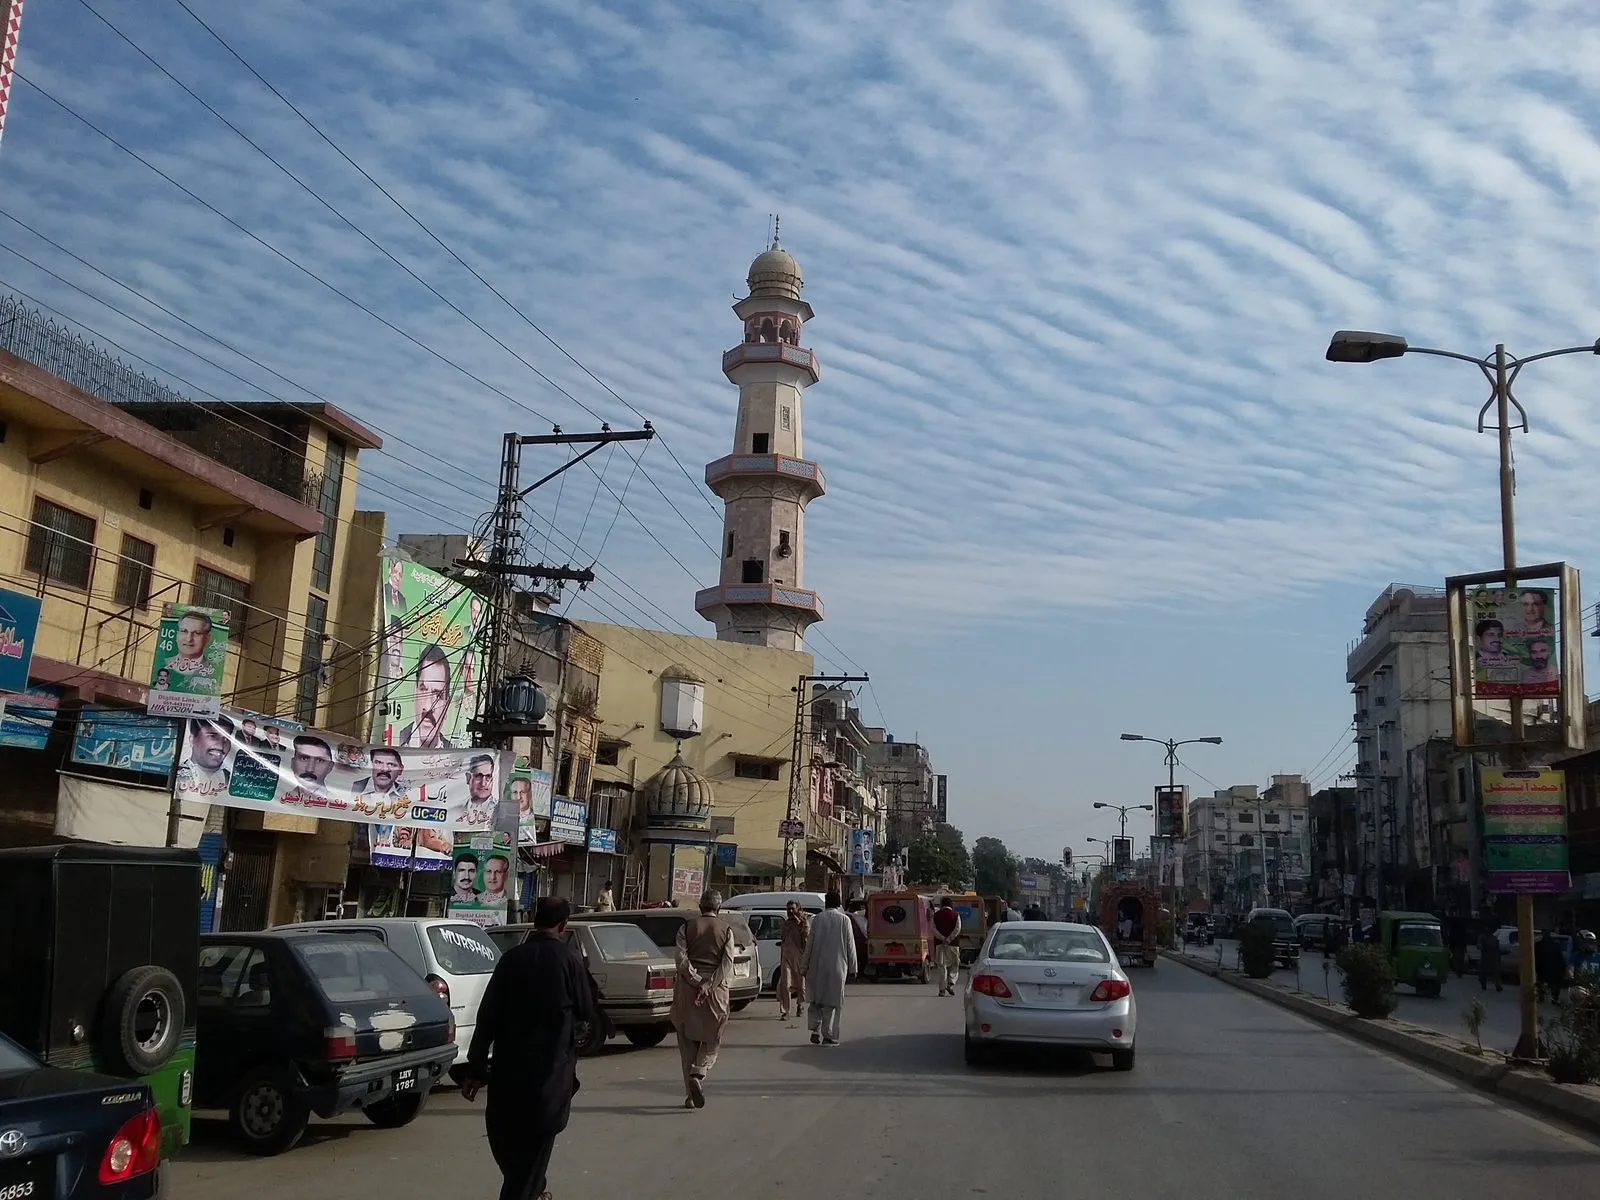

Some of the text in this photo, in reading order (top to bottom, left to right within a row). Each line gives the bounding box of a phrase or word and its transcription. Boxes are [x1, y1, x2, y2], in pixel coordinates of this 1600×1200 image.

[161, 629, 175, 639] UC
[159, 641, 173, 652] 46
[150, 703, 194, 714] HIKVISION
[419, 784, 428, 803] 1
[428, 784, 448, 803] بلاک
[413, 807, 446, 821] UC-46
[439, 927, 495, 961] MURSHAD
[395, 1078, 415, 1092] 1787
